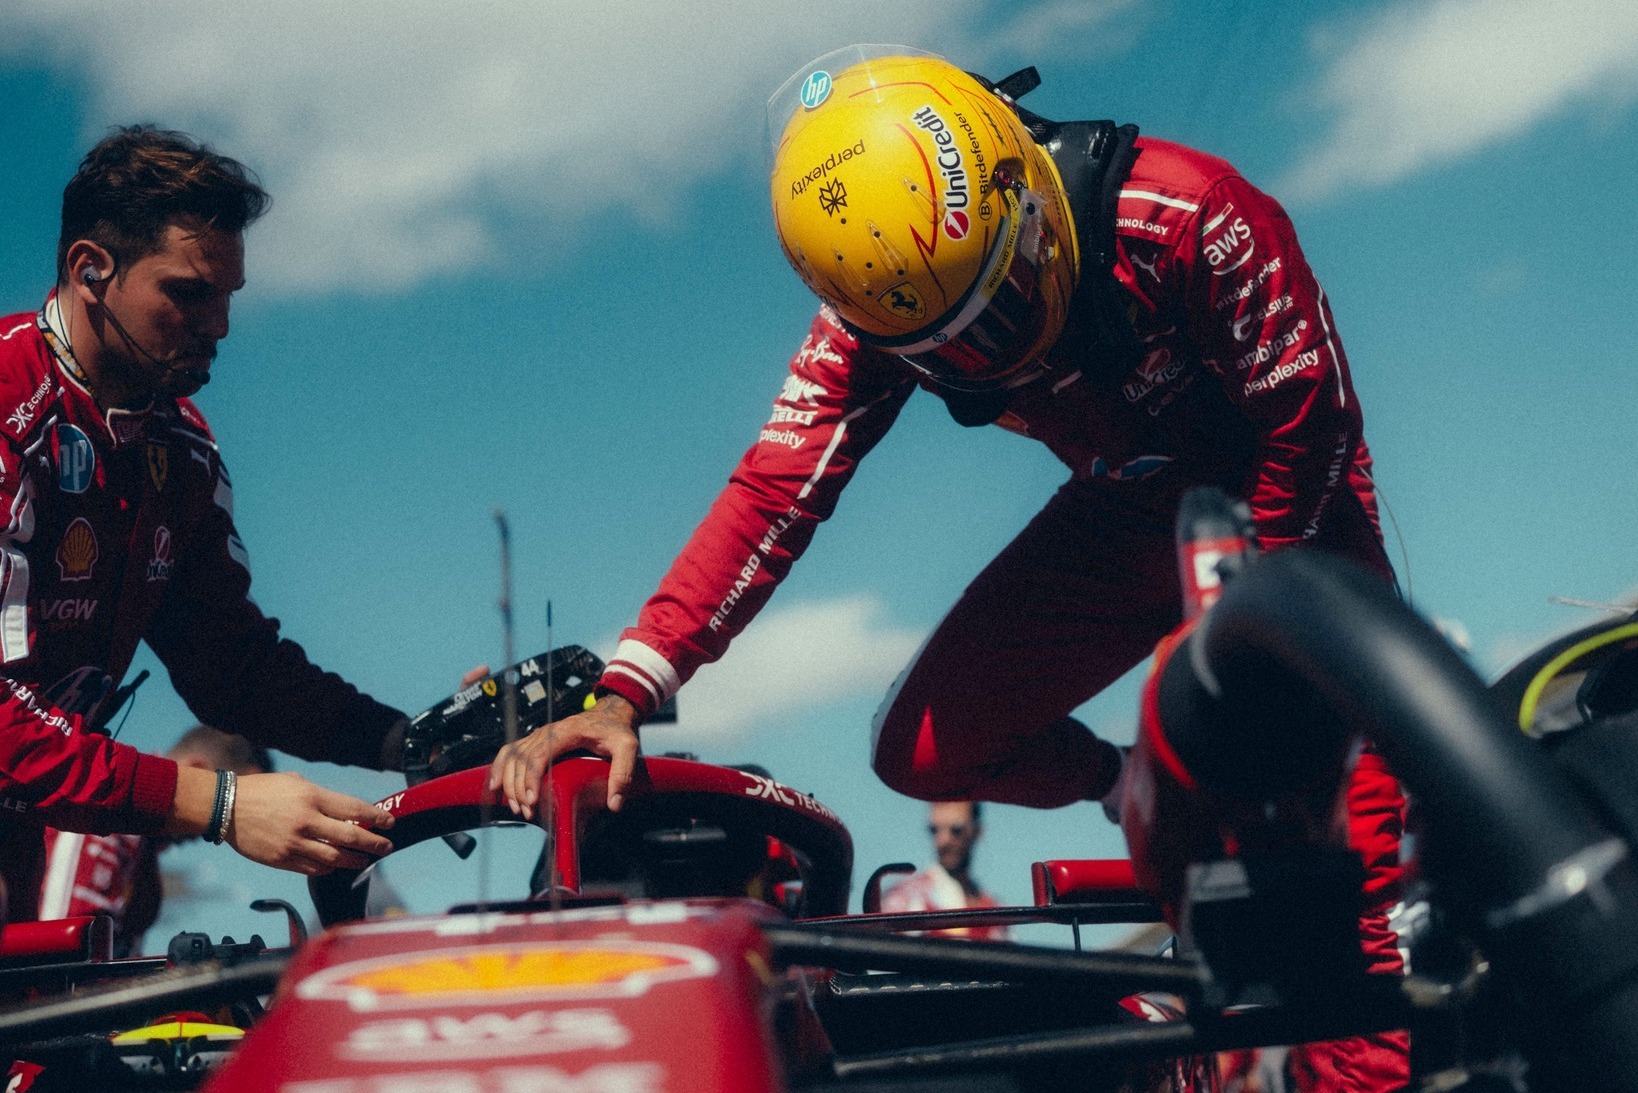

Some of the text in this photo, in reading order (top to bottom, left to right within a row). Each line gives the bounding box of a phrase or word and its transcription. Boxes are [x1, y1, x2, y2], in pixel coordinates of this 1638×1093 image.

[806, 74, 829, 105] hp
[791, 139, 865, 200] perplexity
[912, 106, 968, 210] UniCredit
[954, 112, 989, 194] Bitdefender
[988, 223, 1018, 289] RICHARD MILLE
[1203, 217, 1251, 267] aws
[1244, 349, 1319, 397] perplexity
[759, 428, 806, 449] plexity
[708, 505, 801, 632] RICHARD MILLE
[39, 598, 99, 621] VGW
